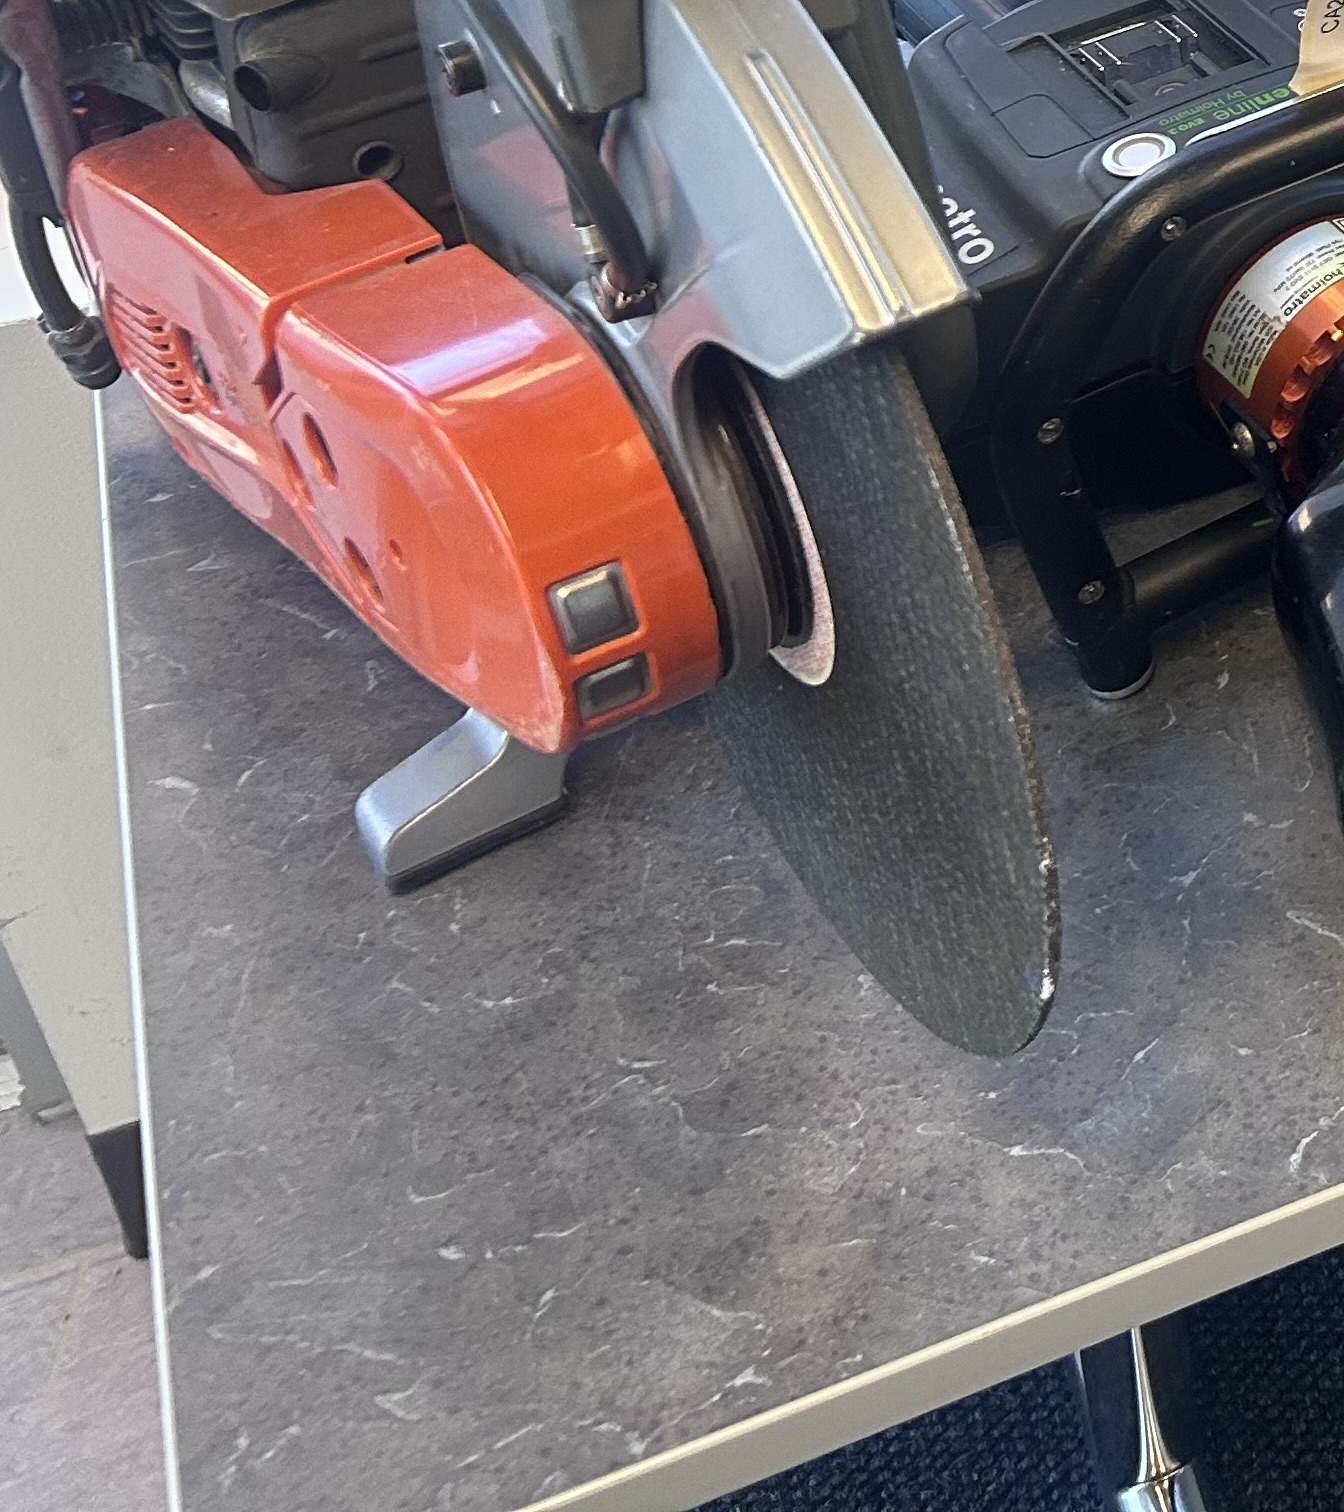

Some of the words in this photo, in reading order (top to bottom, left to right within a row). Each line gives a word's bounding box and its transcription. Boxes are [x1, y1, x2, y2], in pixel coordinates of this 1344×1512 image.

[1159, 98, 1226, 126] Holmatro
[1213, 87, 1291, 121] enline
[1283, 268, 1344, 317] holmatro
